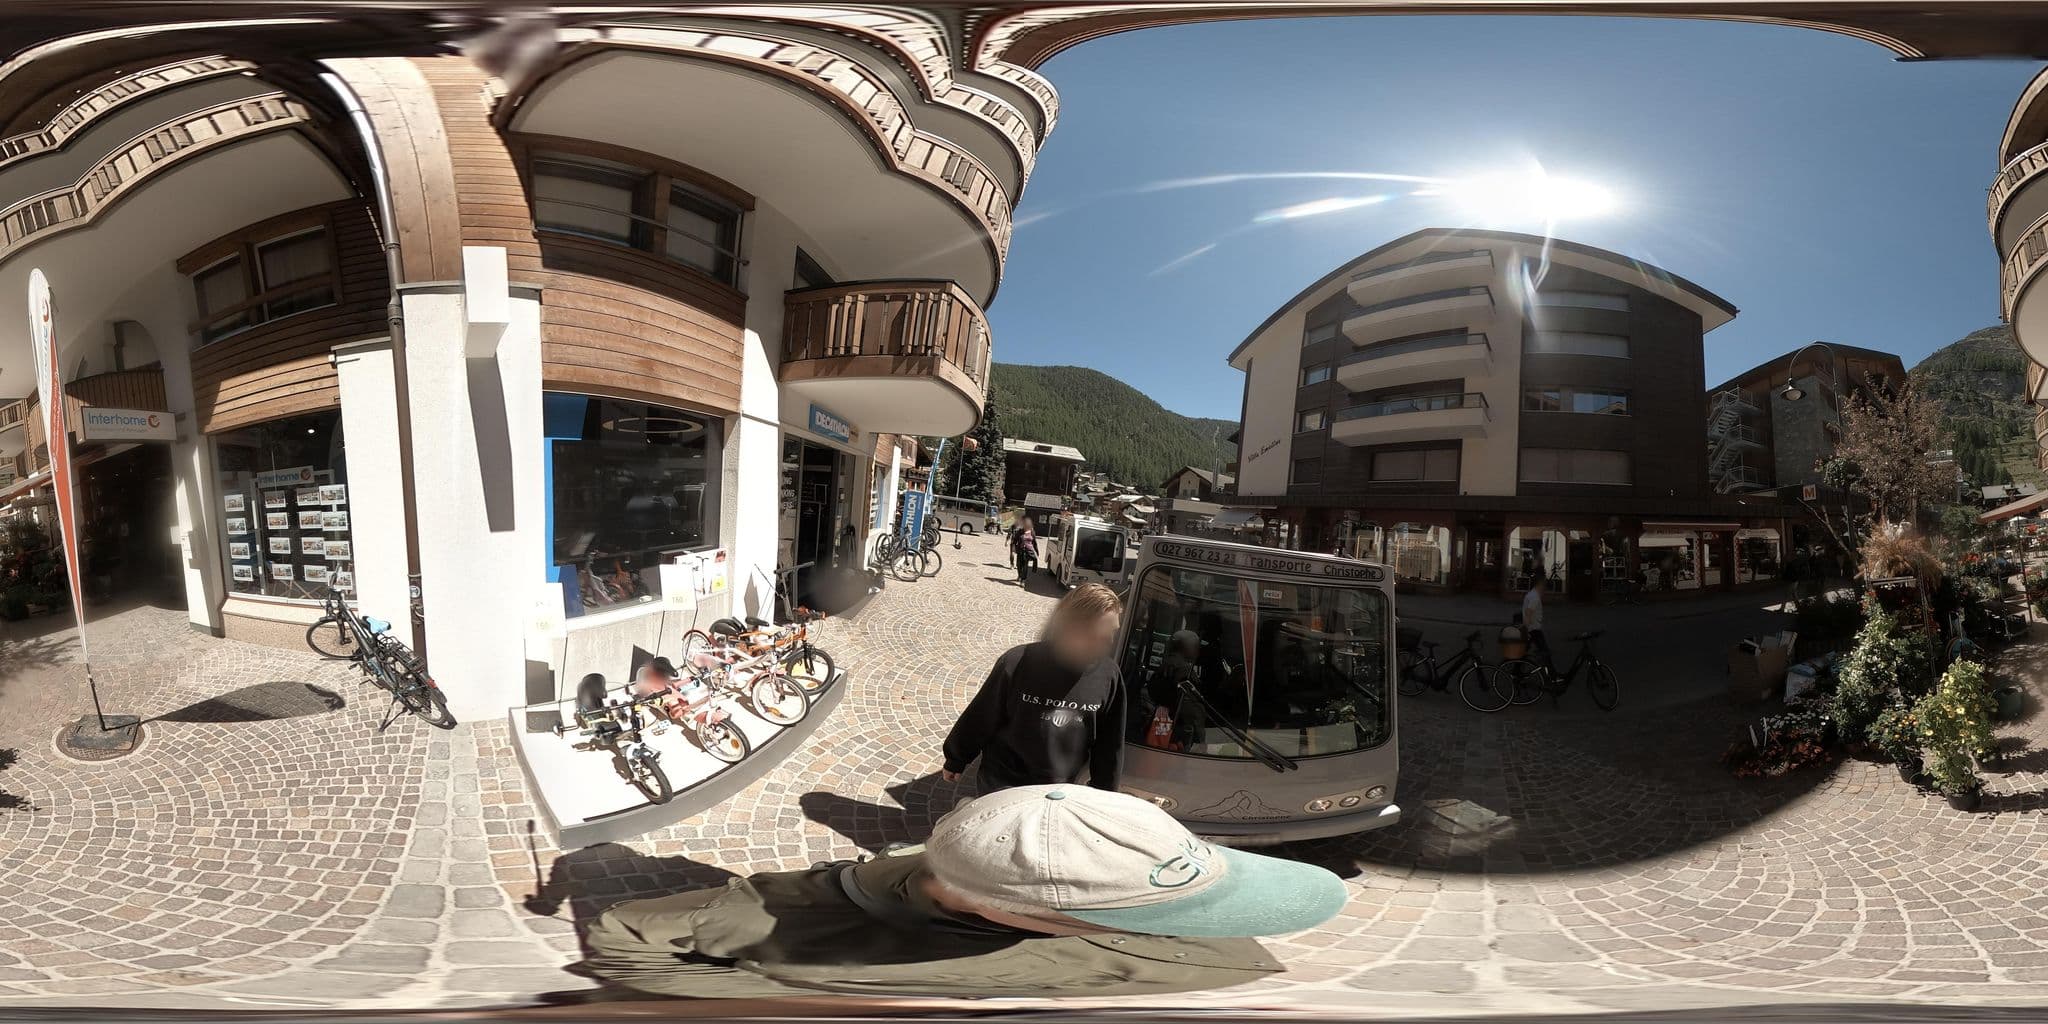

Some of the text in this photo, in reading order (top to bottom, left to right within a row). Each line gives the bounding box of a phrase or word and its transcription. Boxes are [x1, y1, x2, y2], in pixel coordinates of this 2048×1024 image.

[88, 411, 147, 426] Interhome
[1162, 543, 1181, 555] 027
[1185, 547, 1204, 560] 967
[1207, 550, 1220, 562] 23
[1324, 565, 1377, 579] Christophe
[1022, 693, 1041, 705] U.S.
[1045, 698, 1078, 710] POLO
